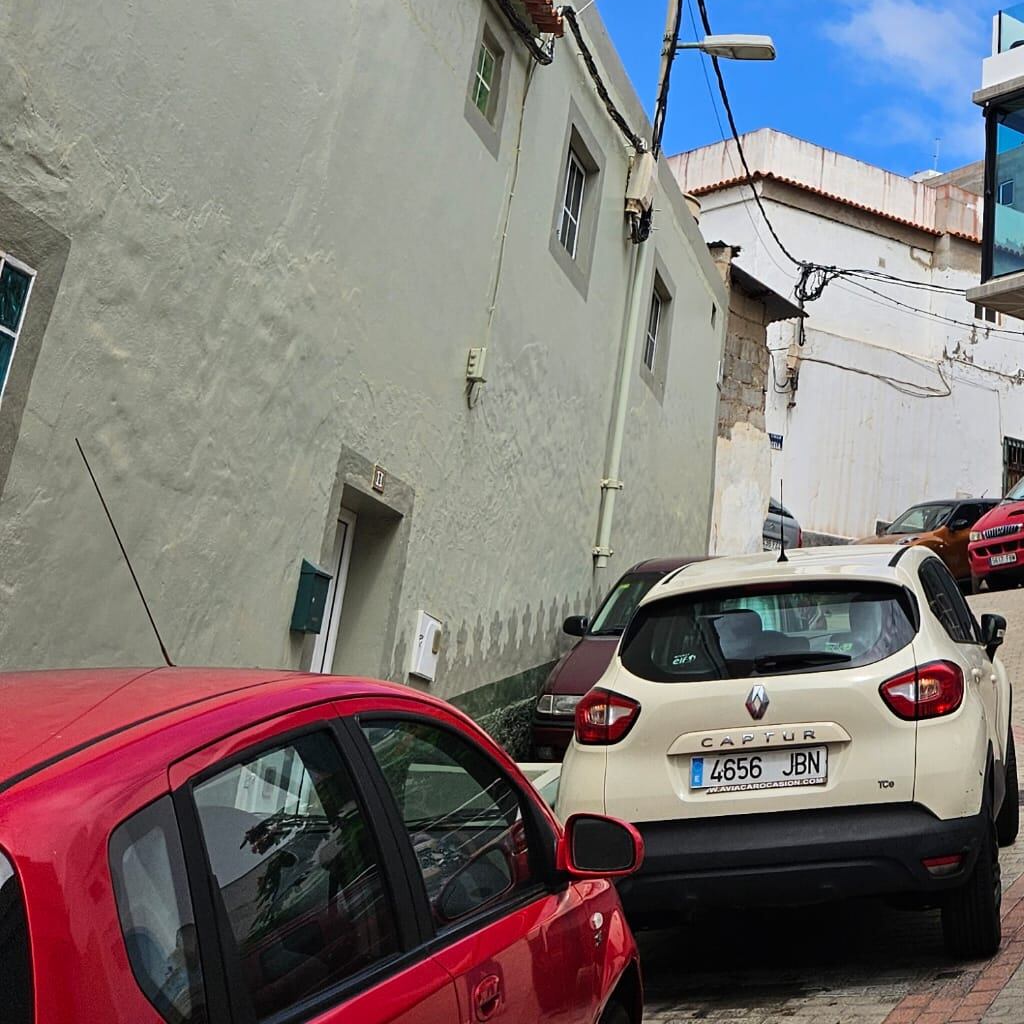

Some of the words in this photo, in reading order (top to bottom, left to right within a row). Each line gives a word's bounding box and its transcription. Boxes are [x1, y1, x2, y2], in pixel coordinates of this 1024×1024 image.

[701, 730, 816, 748] CAPTUR
[710, 756, 762, 782] 4656
[782, 750, 820, 777] JBN
